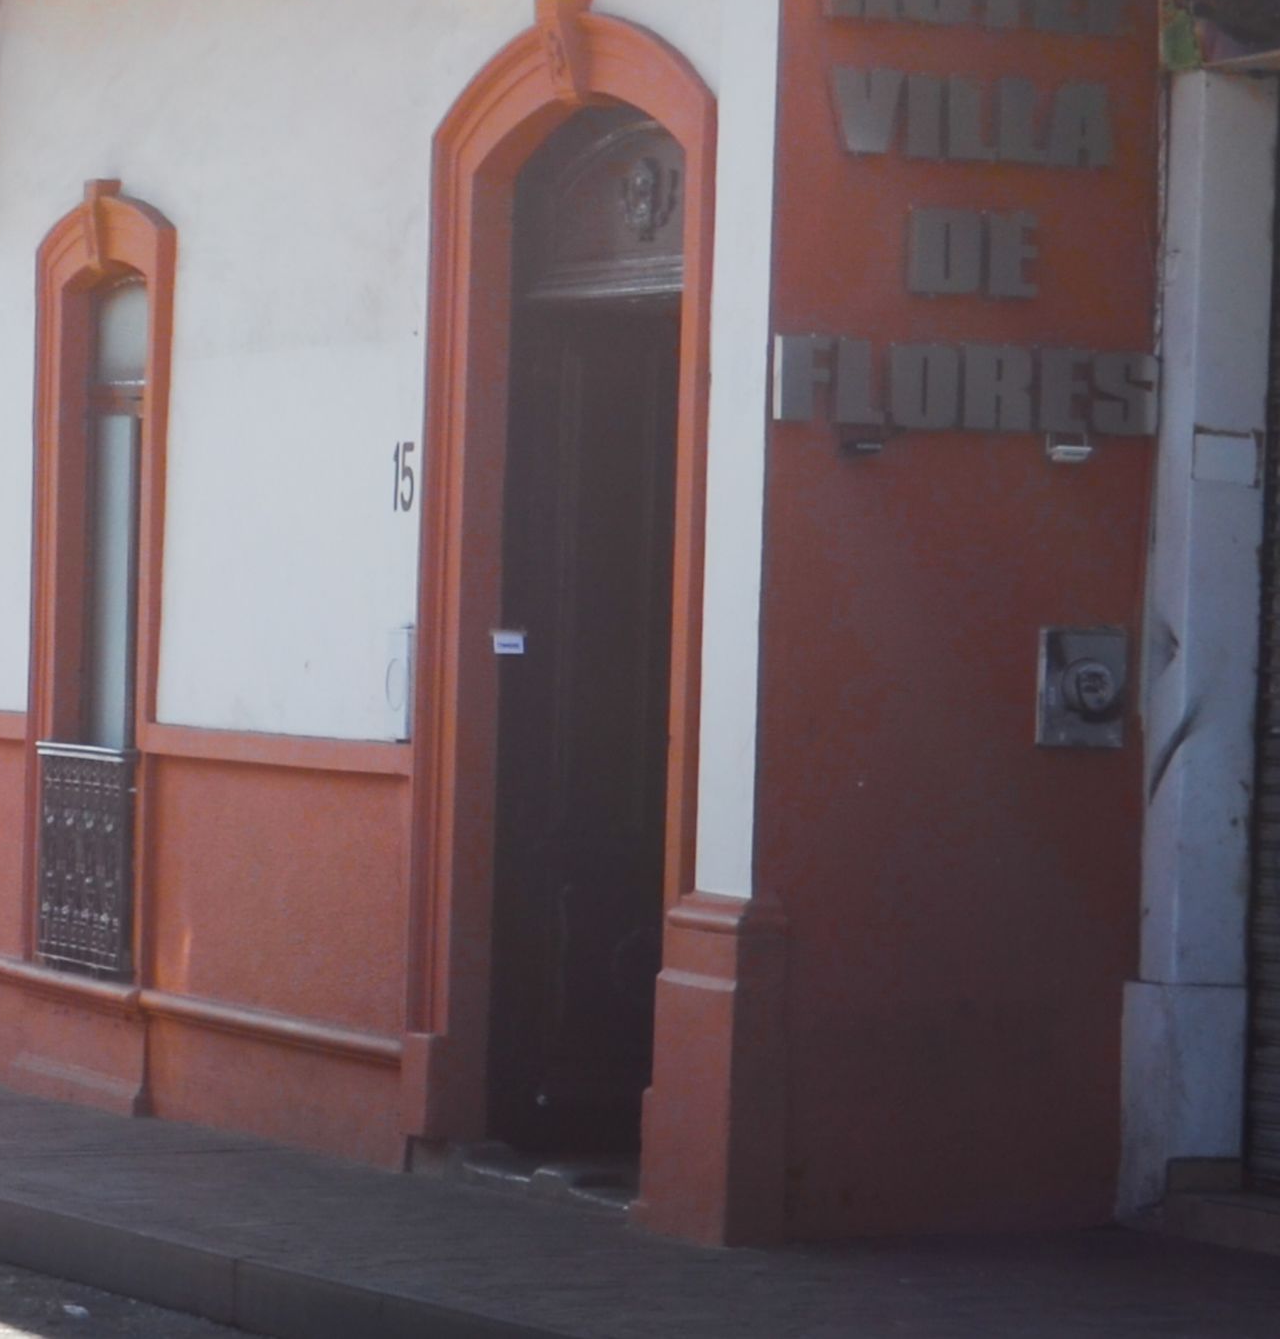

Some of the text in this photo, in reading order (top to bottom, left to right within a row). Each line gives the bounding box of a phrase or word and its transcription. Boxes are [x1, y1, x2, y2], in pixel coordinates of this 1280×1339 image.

[829, 66, 1116, 168] VILLA
[908, 207, 1040, 300] DE
[773, 334, 1159, 436] FLORES
[392, 440, 415, 512] 15
